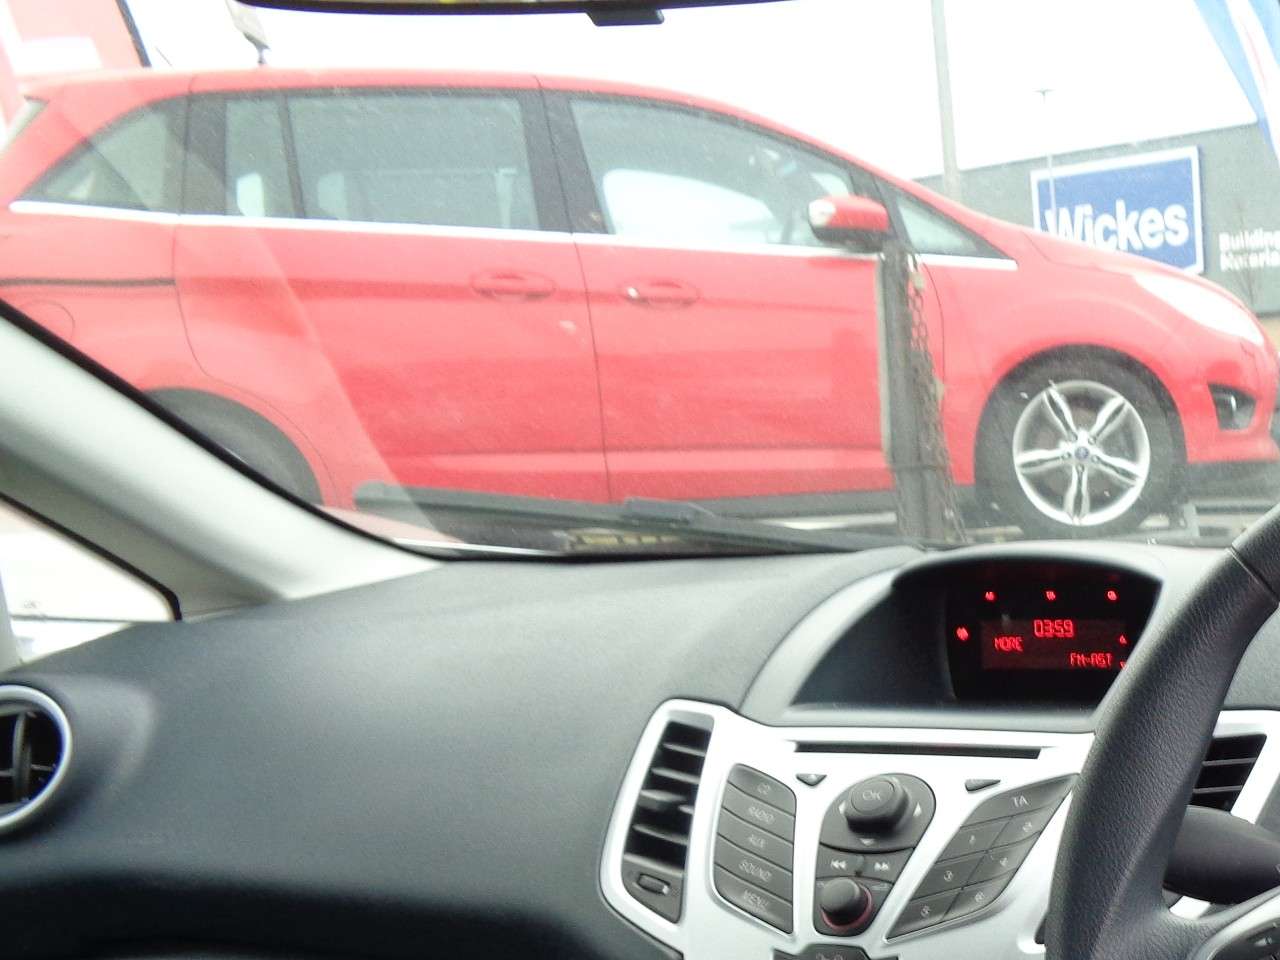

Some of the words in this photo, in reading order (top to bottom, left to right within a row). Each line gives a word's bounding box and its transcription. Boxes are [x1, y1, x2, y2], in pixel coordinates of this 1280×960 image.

[1044, 199, 1190, 251] Wickes
[1033, 618, 1075, 639] 03:59
[994, 636, 1024, 652] MORE
[862, 790, 882, 801] OK
[1013, 796, 1030, 807] TA
[739, 860, 773, 882] SOUND
